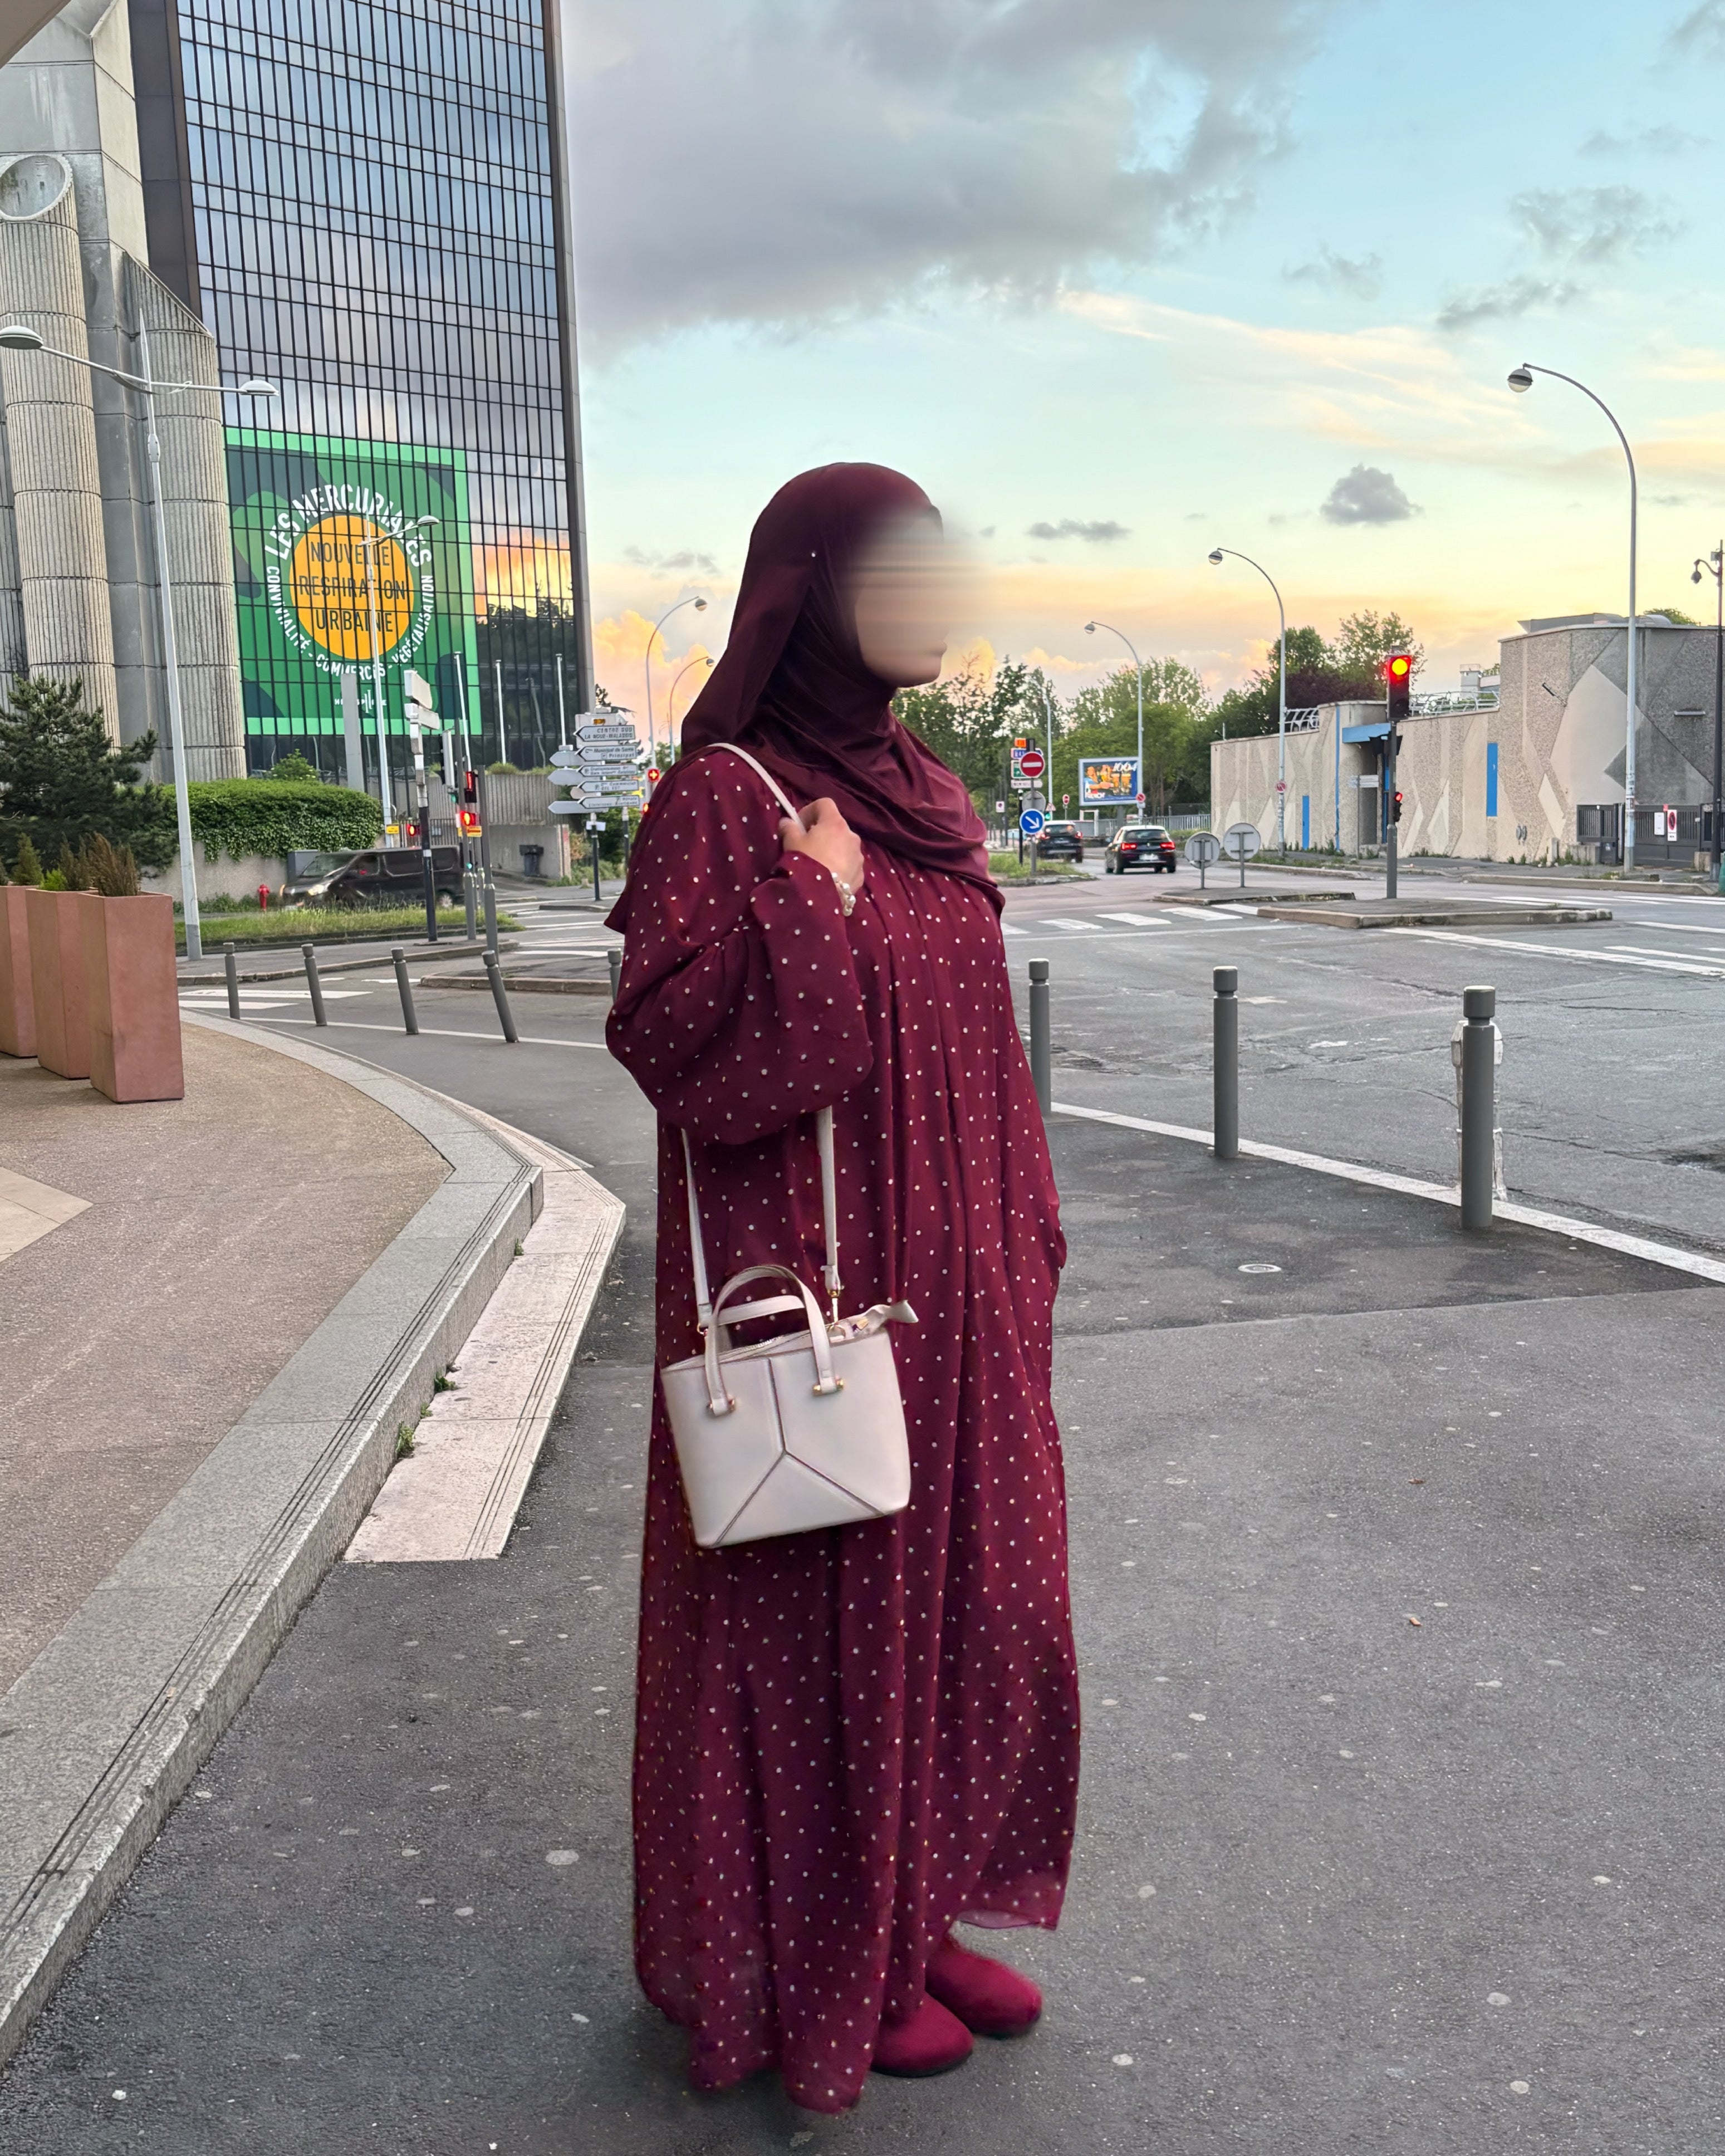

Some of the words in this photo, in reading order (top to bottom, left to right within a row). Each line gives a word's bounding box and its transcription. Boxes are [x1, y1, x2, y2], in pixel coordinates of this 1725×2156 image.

[264, 512, 301, 560] LES
[292, 483, 432, 567] MERCURIALES
[311, 541, 390, 566] NOUVELLE
[316, 609, 393, 633] URBAINE
